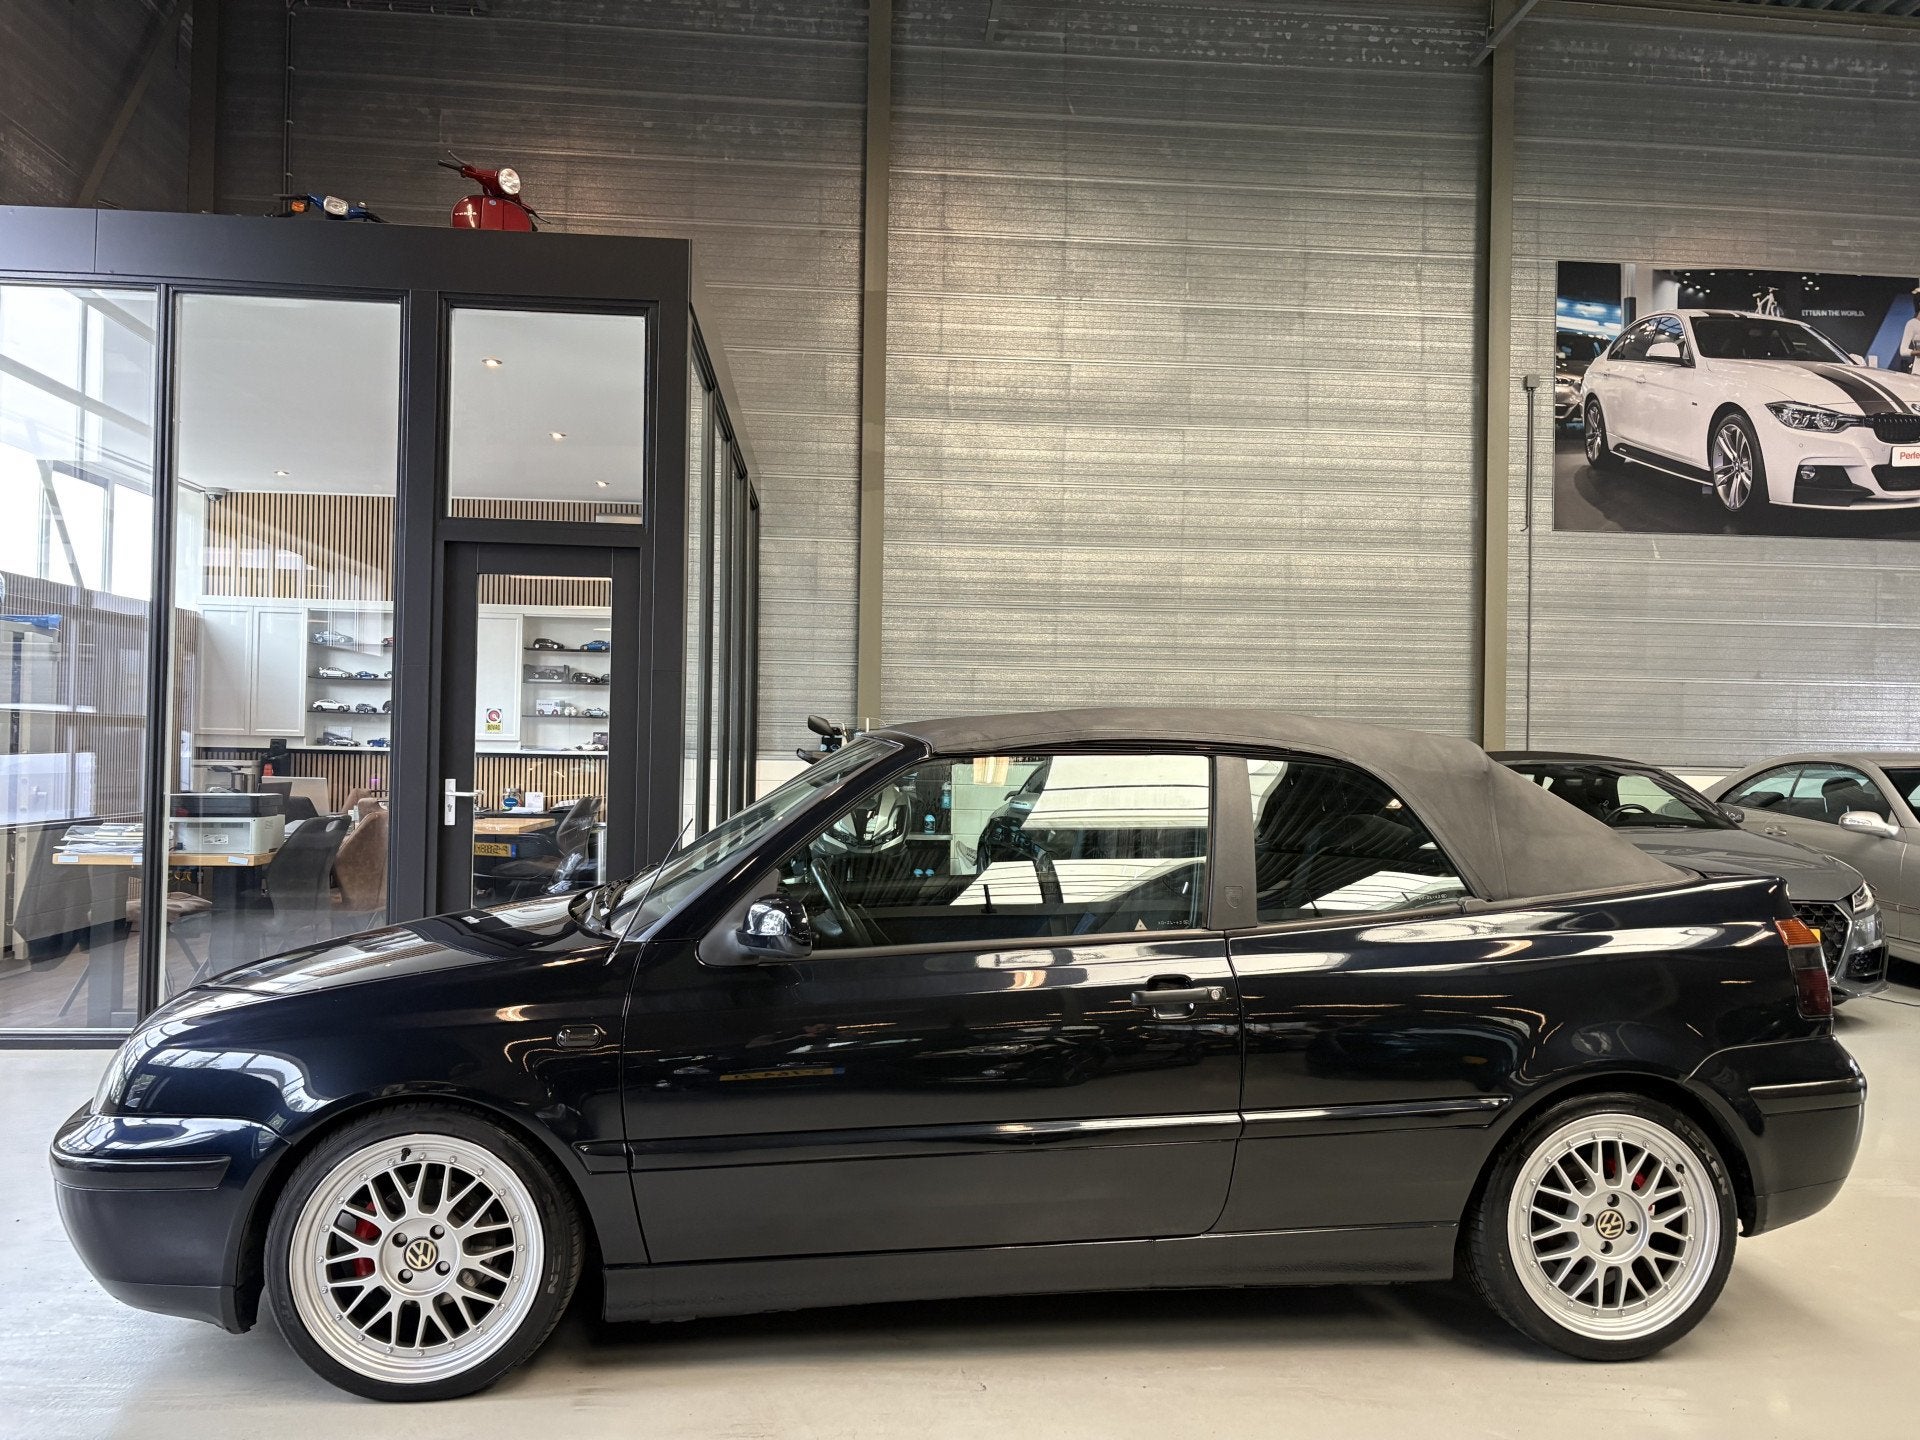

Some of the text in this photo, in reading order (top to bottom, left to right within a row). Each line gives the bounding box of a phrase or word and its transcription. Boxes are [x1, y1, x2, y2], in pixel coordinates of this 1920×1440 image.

[1828, 309, 1840, 317] THE
[1674, 1118, 1729, 1196] NEXEN
[405, 1239, 437, 1270] VW
